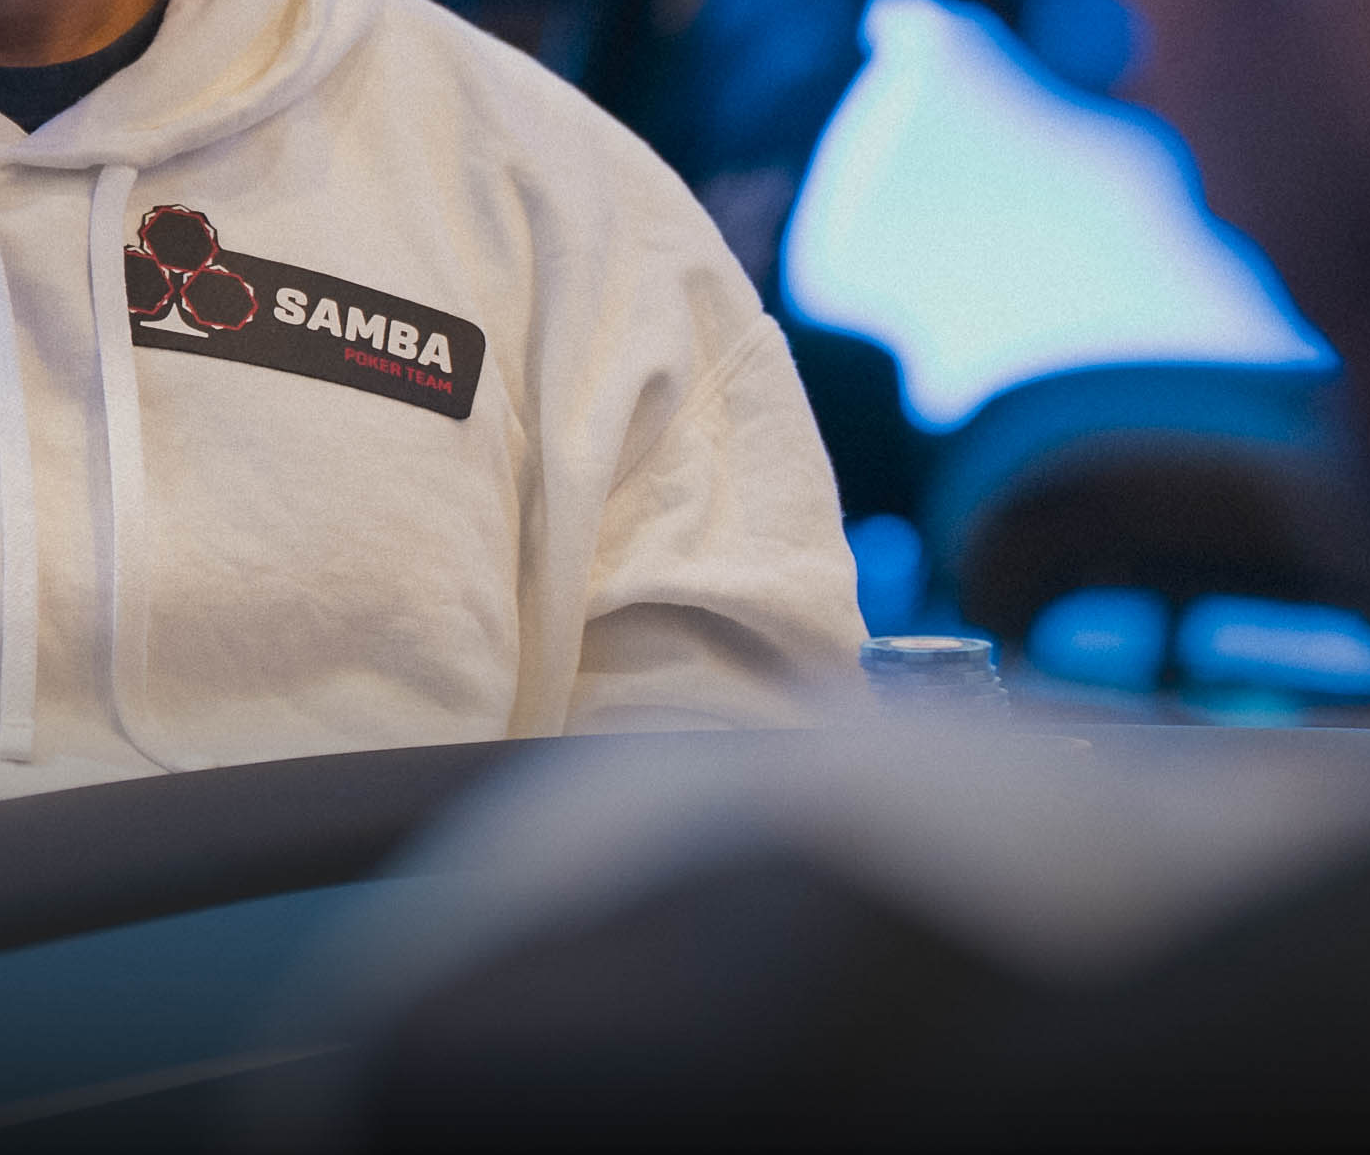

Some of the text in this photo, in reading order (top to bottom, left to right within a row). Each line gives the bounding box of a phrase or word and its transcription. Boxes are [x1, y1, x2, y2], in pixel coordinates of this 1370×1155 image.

[273, 287, 453, 374] SAMBA
[344, 347, 453, 394] POKER TEAM
